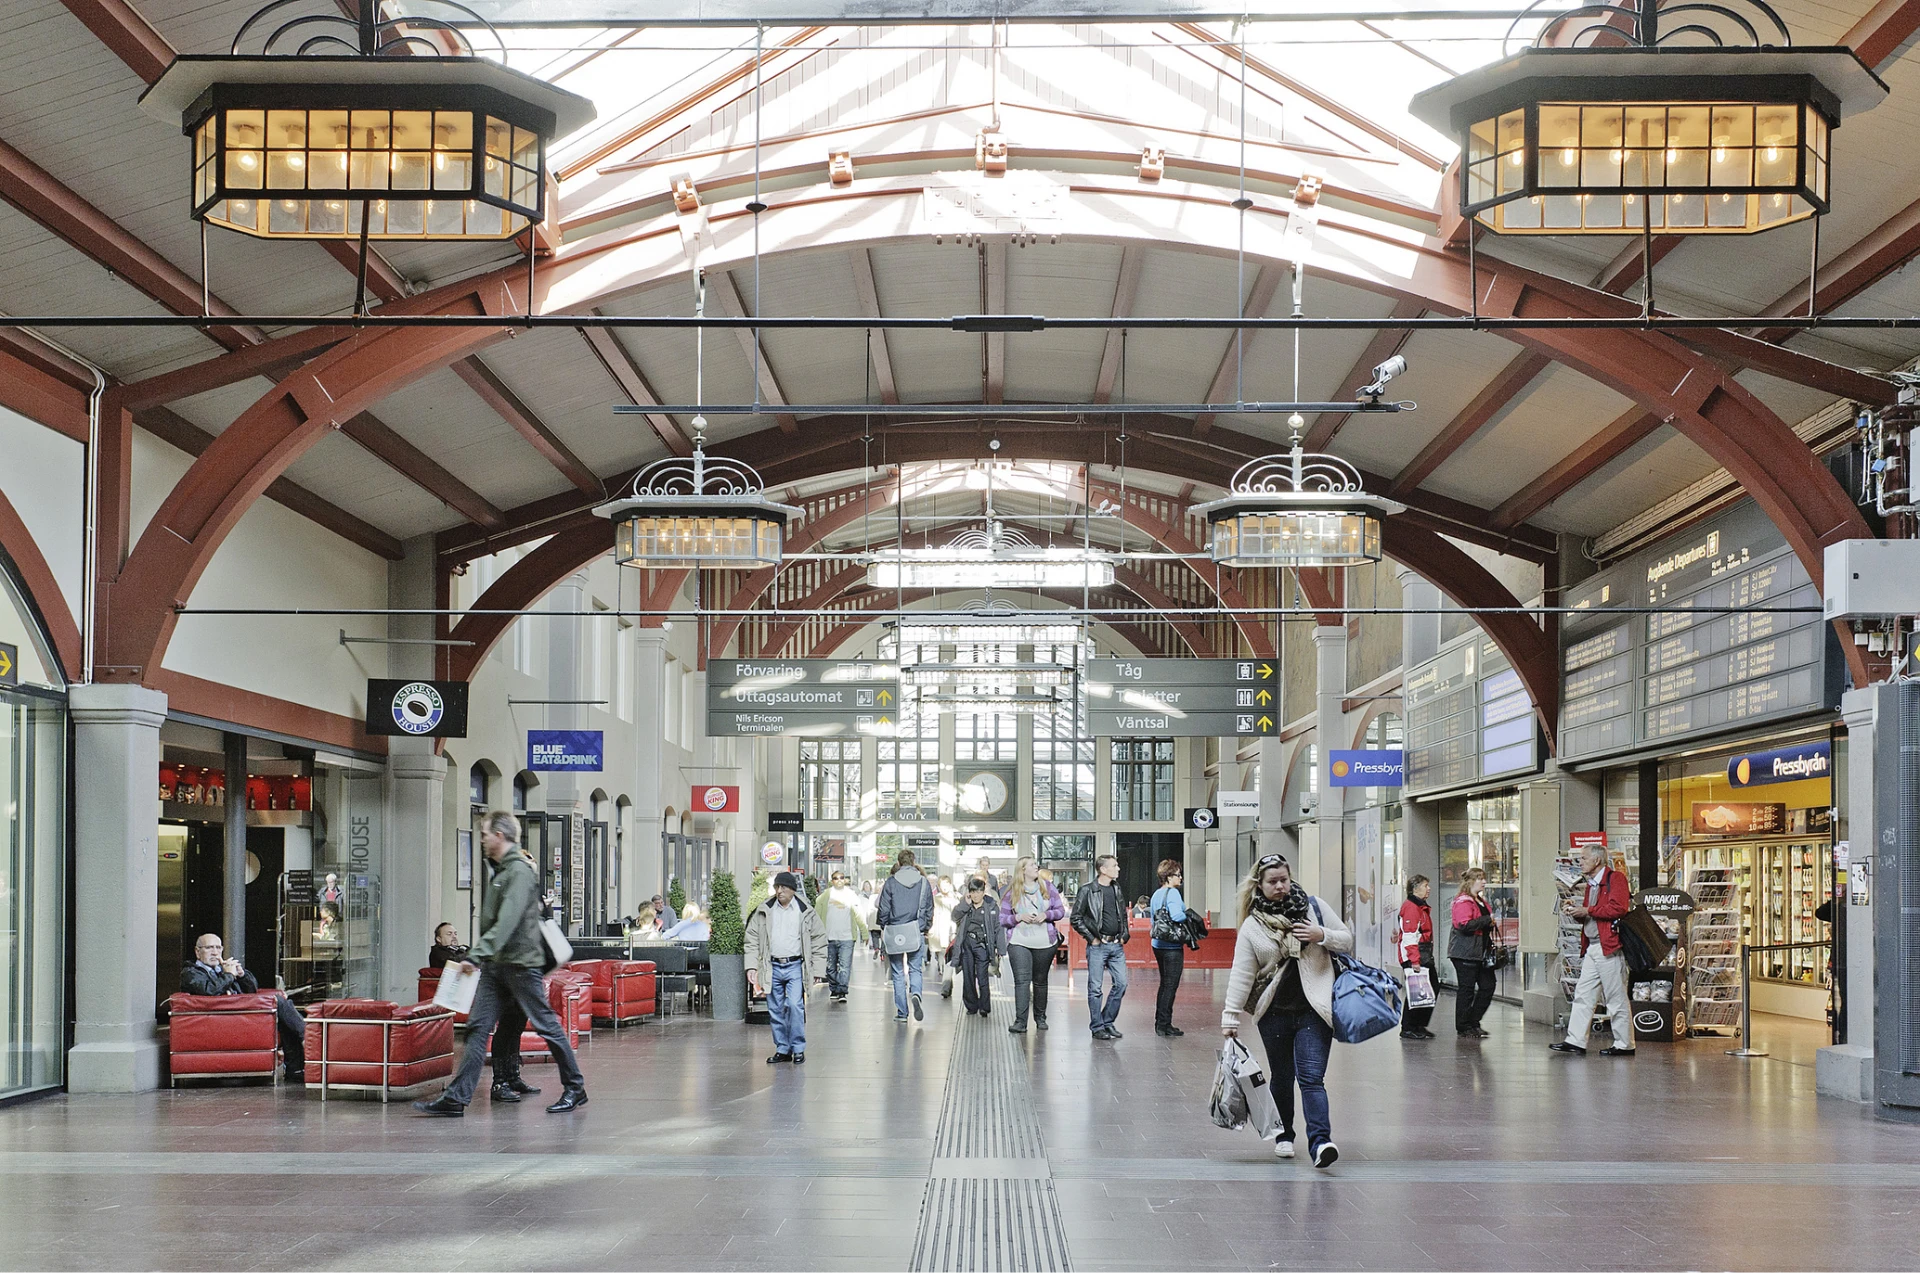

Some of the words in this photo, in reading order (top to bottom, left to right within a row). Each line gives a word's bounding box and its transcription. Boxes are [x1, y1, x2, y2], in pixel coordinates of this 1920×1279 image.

[1674, 544, 1706, 569] Departures
[736, 664, 803, 679] Förvaring
[1116, 663, 1142, 680] Tåg
[395, 684, 441, 707] ESPRESSO
[735, 690, 843, 706] Uttagsautomat
[1116, 690, 1181, 703] Tletter
[397, 716, 436, 732] HOUSE
[736, 723, 784, 732] Terminalen
[1116, 715, 1168, 729] Väntsal
[533, 745, 564, 754] BLUE
[533, 755, 598, 765] EAT&DRINK
[1773, 752, 1826, 777] Pressbyrån
[707, 796, 725, 804] KING
[764, 850, 780, 859] KING
[1643, 894, 1681, 904] NYBAKAT
